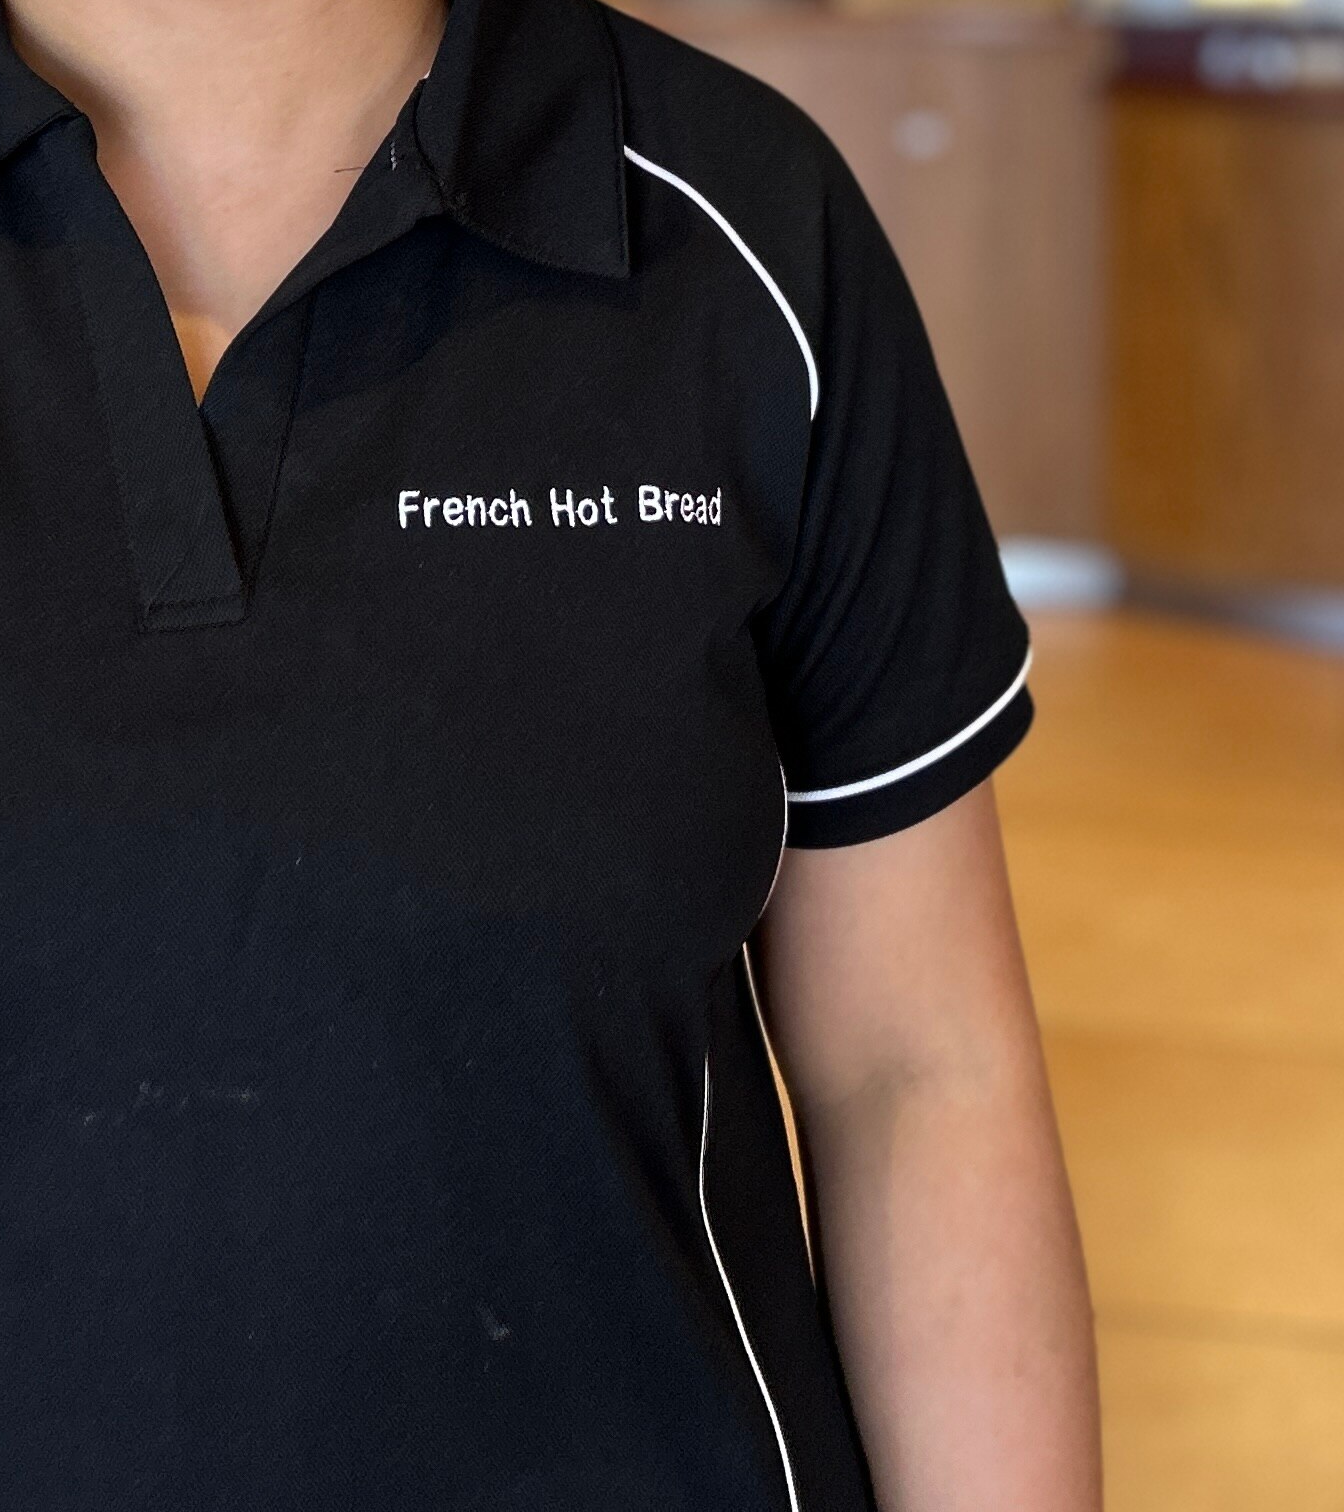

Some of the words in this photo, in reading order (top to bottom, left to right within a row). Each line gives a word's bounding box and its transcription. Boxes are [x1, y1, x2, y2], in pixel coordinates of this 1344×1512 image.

[398, 488, 533, 529] French
[549, 485, 618, 528] Hot
[638, 484, 722, 527] Bread
